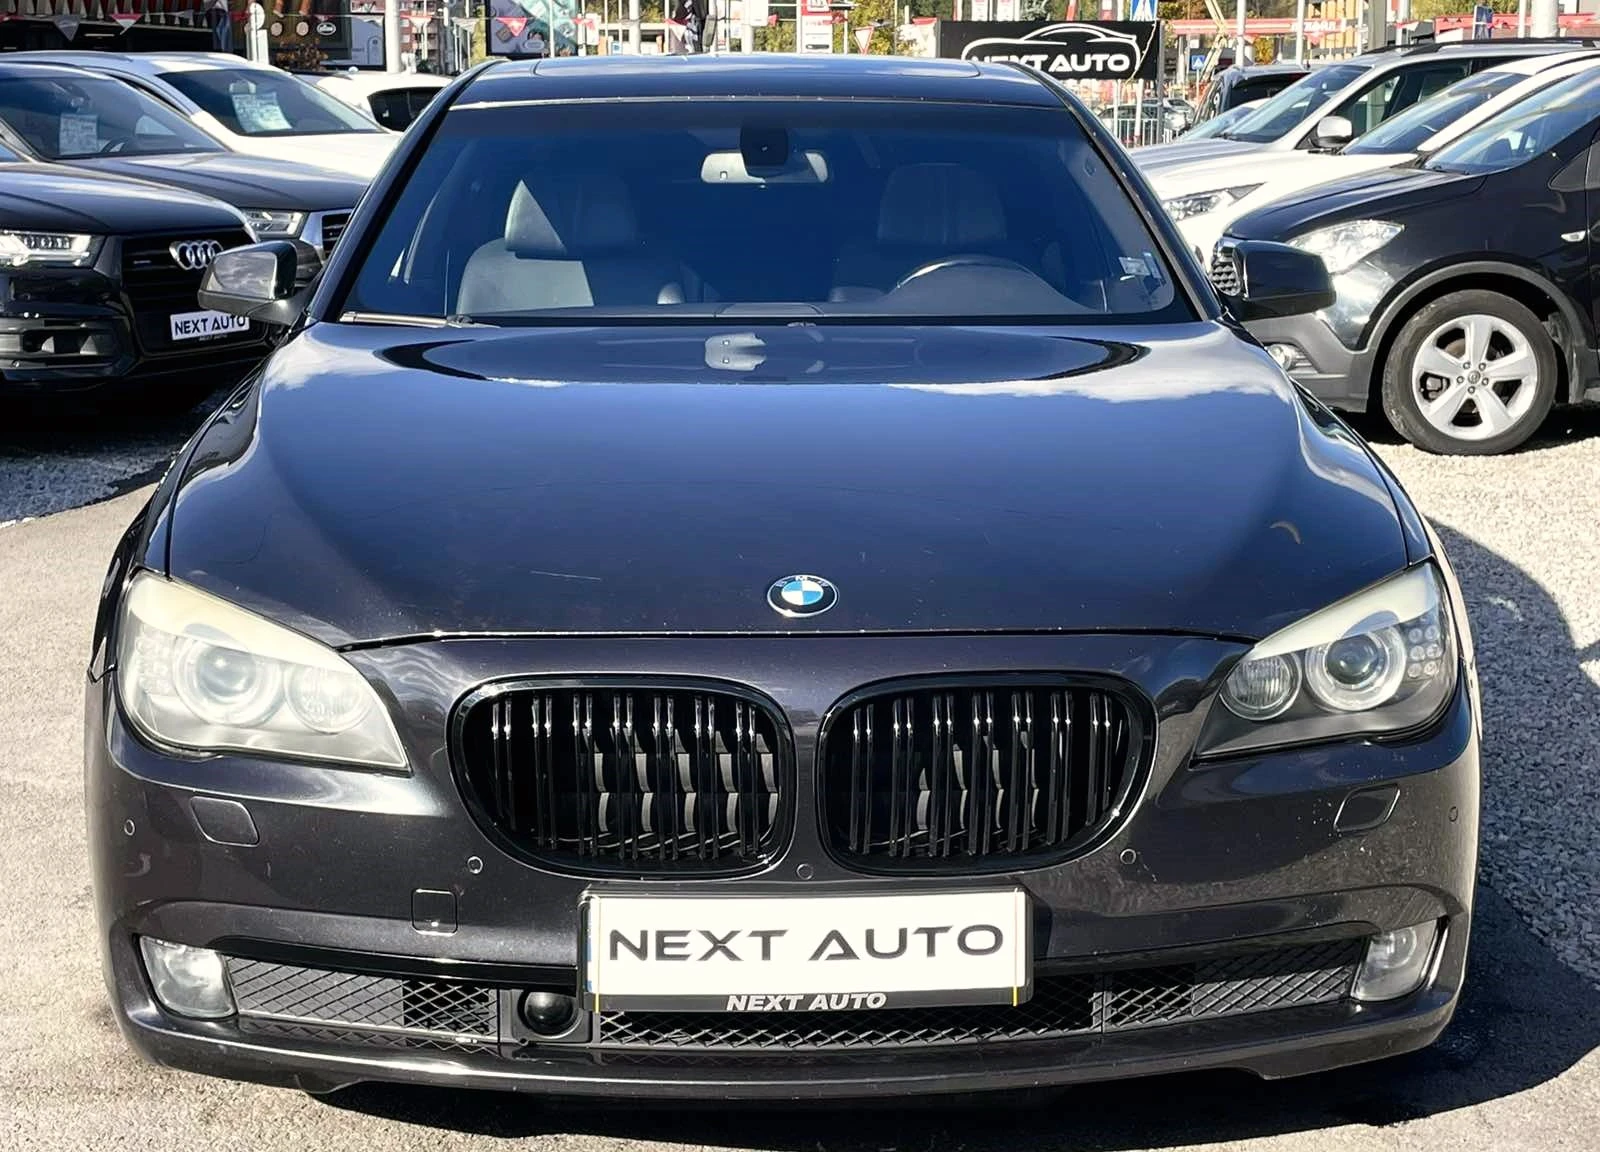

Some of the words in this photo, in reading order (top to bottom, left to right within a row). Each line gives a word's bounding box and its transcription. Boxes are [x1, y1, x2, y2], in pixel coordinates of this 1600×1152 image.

[1048, 53, 1130, 72] AUTO
[174, 318, 208, 336] NEXT
[212, 314, 246, 331] AUTO
[609, 929, 788, 961] NEXT
[808, 924, 1004, 961] AUTO
[726, 995, 804, 1012] NEXT
[809, 993, 887, 1011] AUTO
